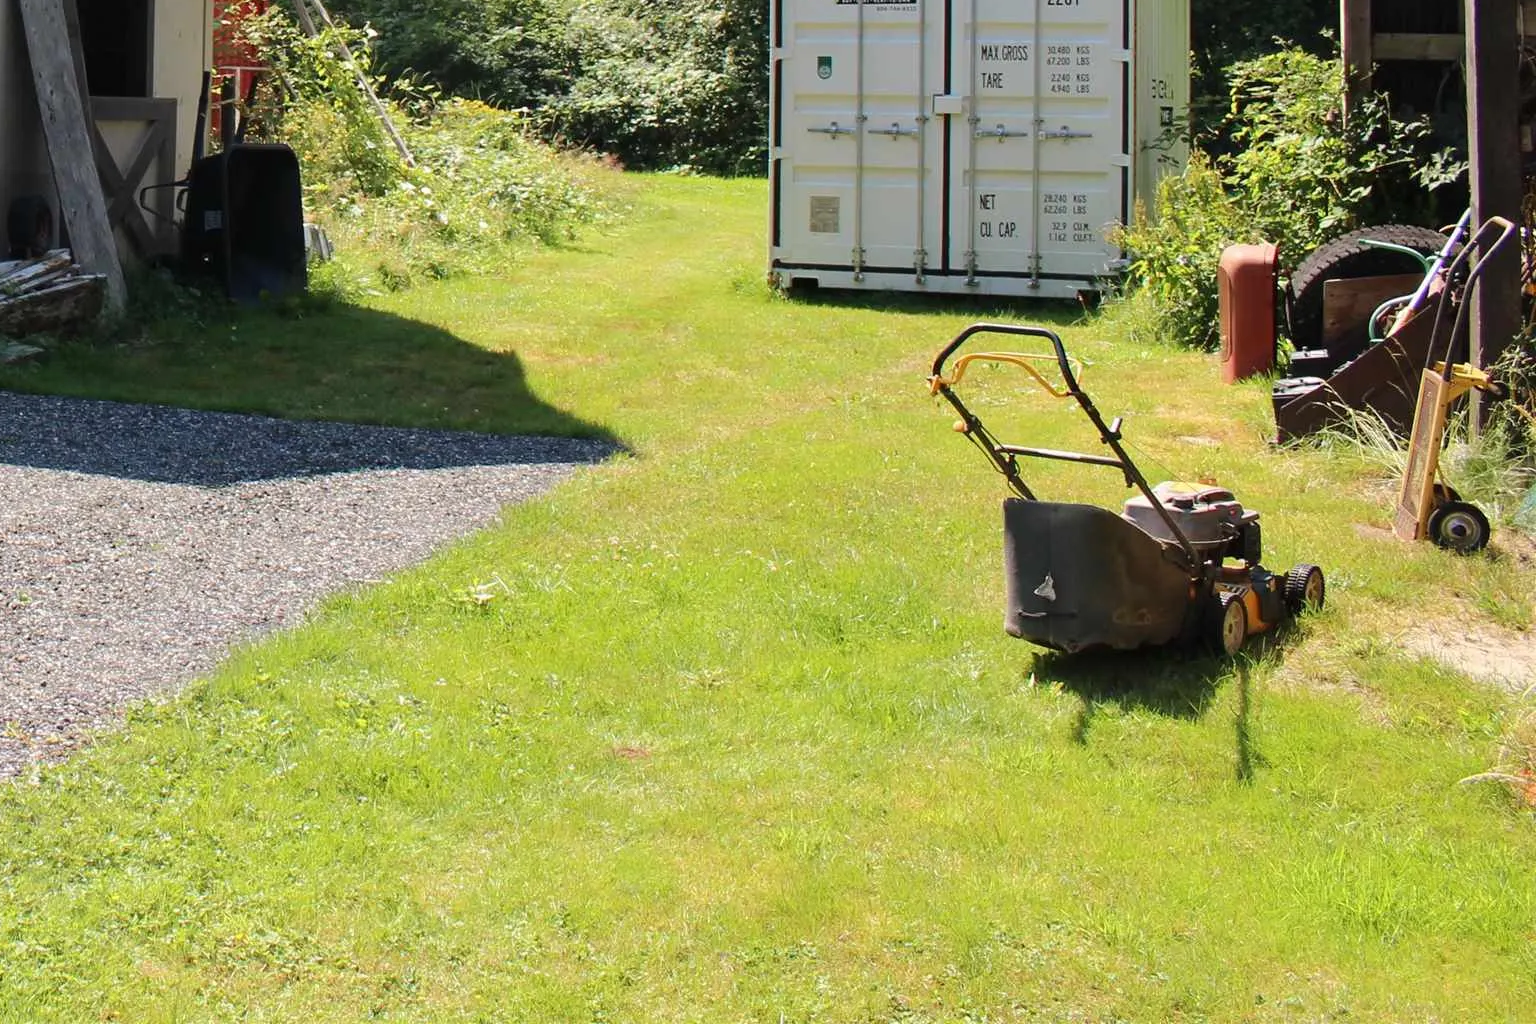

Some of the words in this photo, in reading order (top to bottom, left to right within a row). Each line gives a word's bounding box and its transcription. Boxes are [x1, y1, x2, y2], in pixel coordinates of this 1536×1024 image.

[1076, 45, 1091, 55] KGS
[1076, 57, 1091, 66] LBS
[981, 72, 1004, 89] TARE
[1076, 73, 1091, 82] KGS
[1076, 84, 1091, 93] LBS
[979, 194, 996, 210] NET
[1072, 194, 1088, 204] KGS
[1072, 205, 1088, 215] LBS
